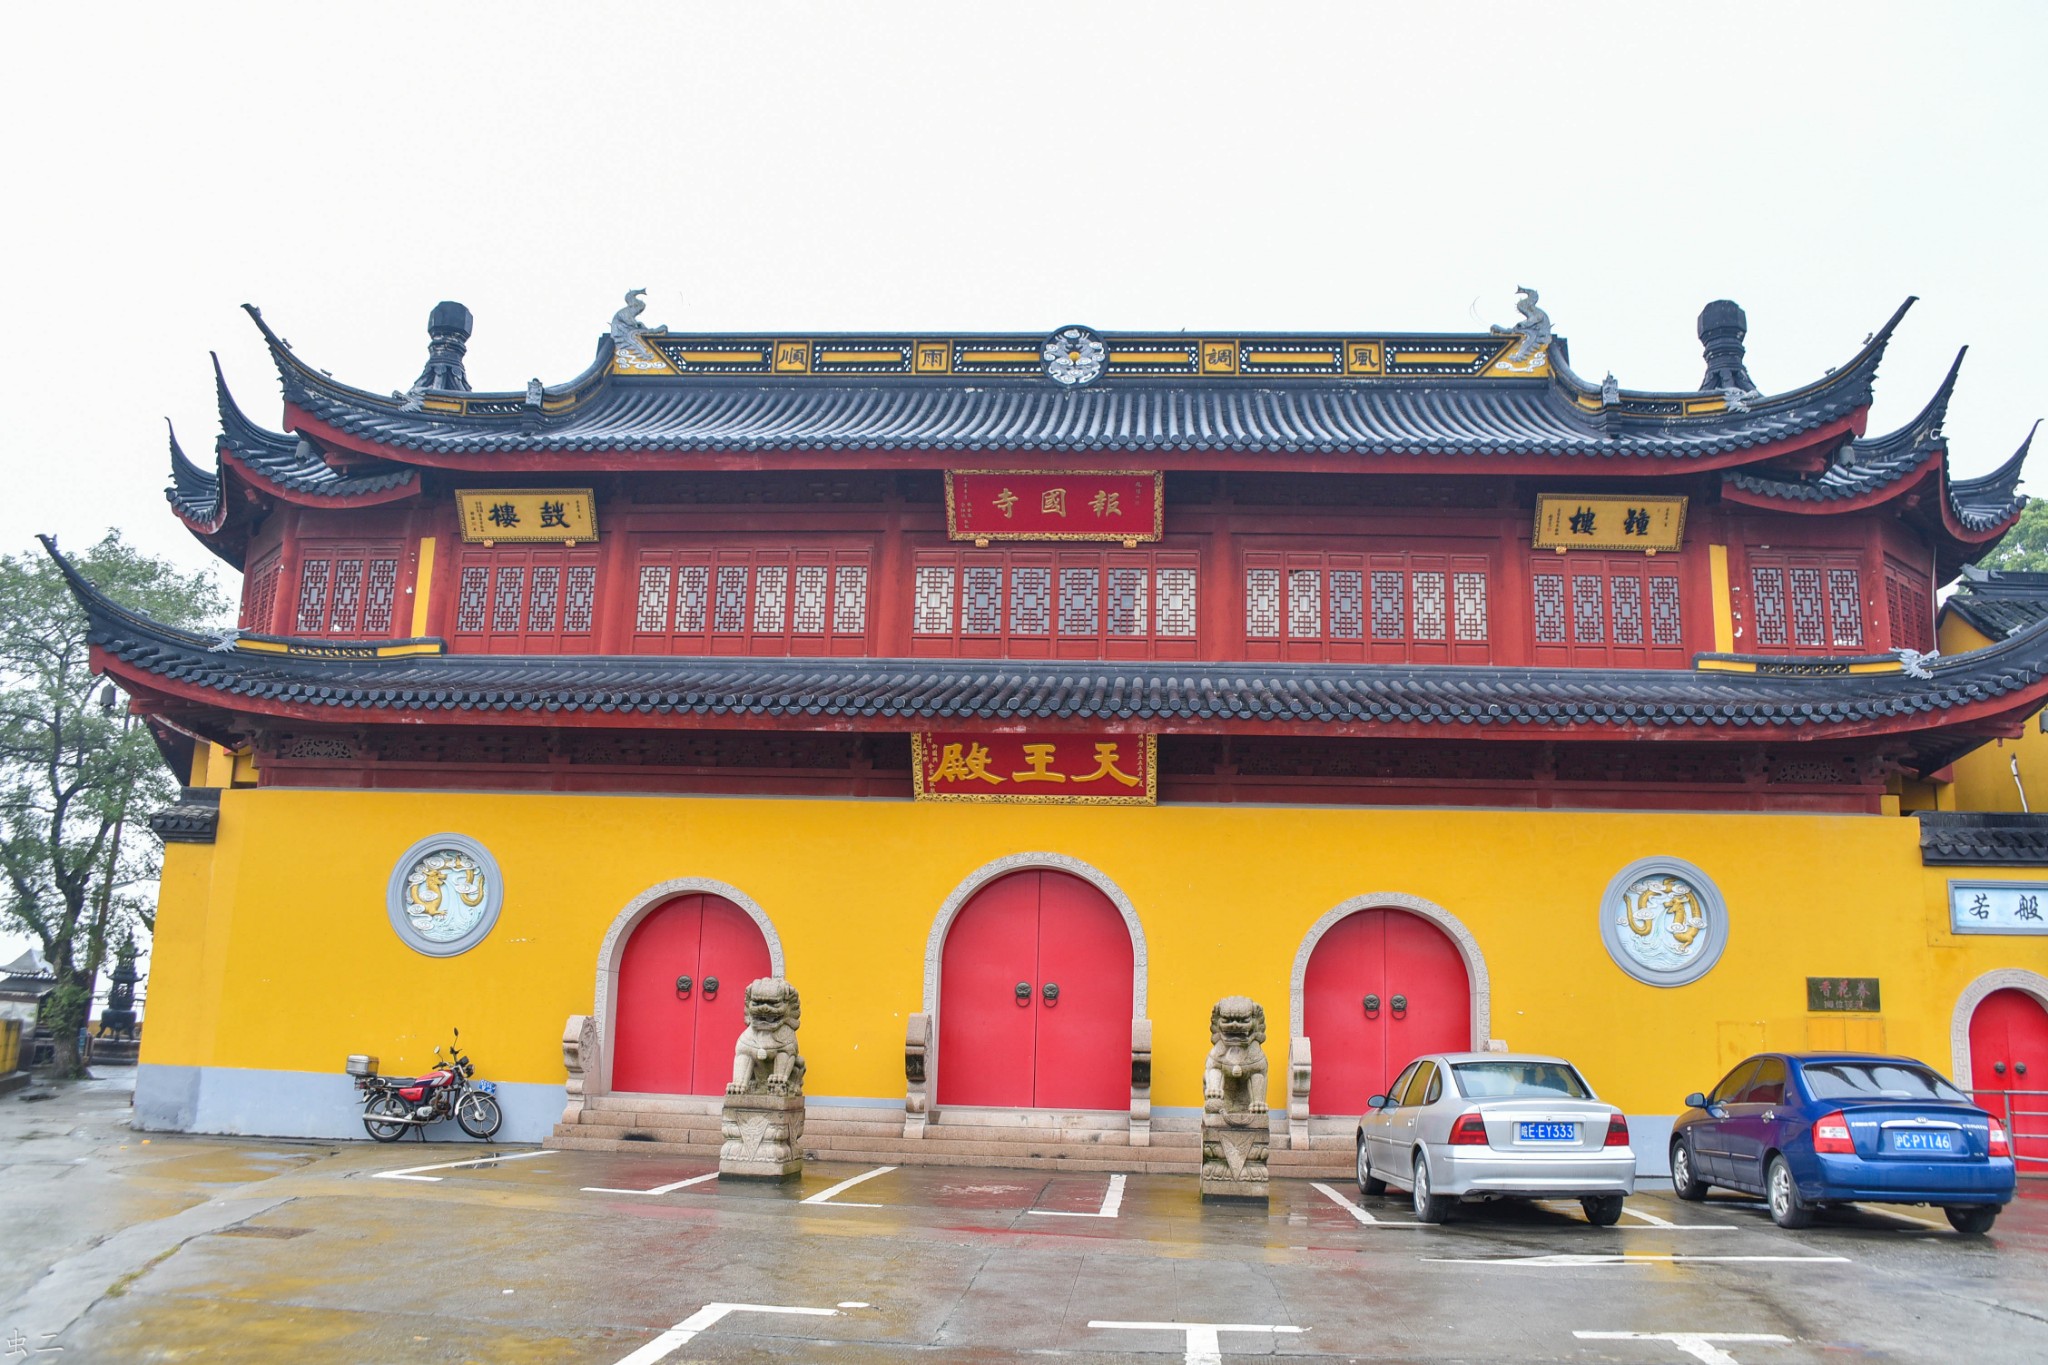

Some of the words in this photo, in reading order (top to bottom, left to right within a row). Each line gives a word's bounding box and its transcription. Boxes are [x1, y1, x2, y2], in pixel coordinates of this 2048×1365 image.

[779, 347, 806, 366] 順
[921, 349, 946, 367] 雨
[1205, 348, 1232, 368] 調
[1350, 349, 1378, 368] 風
[992, 488, 1123, 519] 報國寺
[928, 741, 1140, 787] 天王殿
